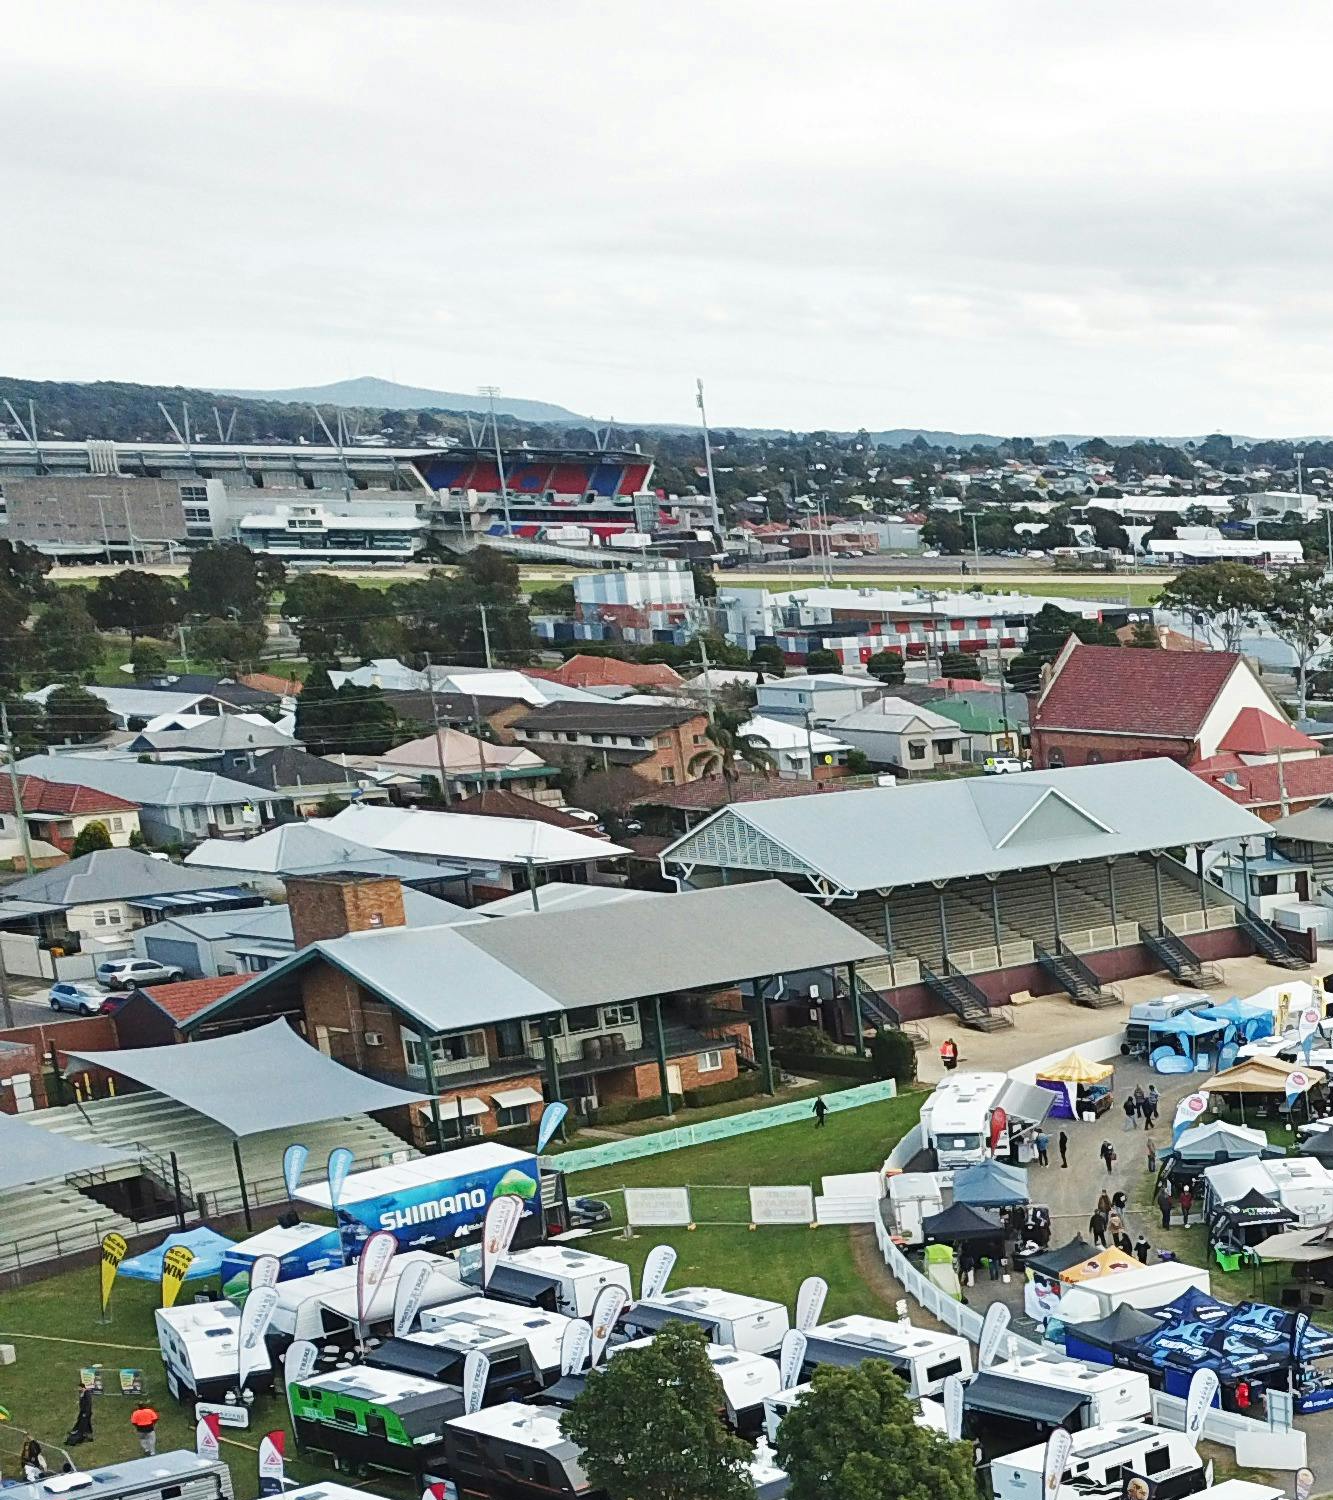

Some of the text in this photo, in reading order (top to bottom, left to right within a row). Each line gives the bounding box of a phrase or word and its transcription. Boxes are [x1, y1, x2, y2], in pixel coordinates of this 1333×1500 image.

[380, 1189, 486, 1231] SHIMANO
[102, 1250, 119, 1268] WIN
[163, 1262, 185, 1281] WIN
